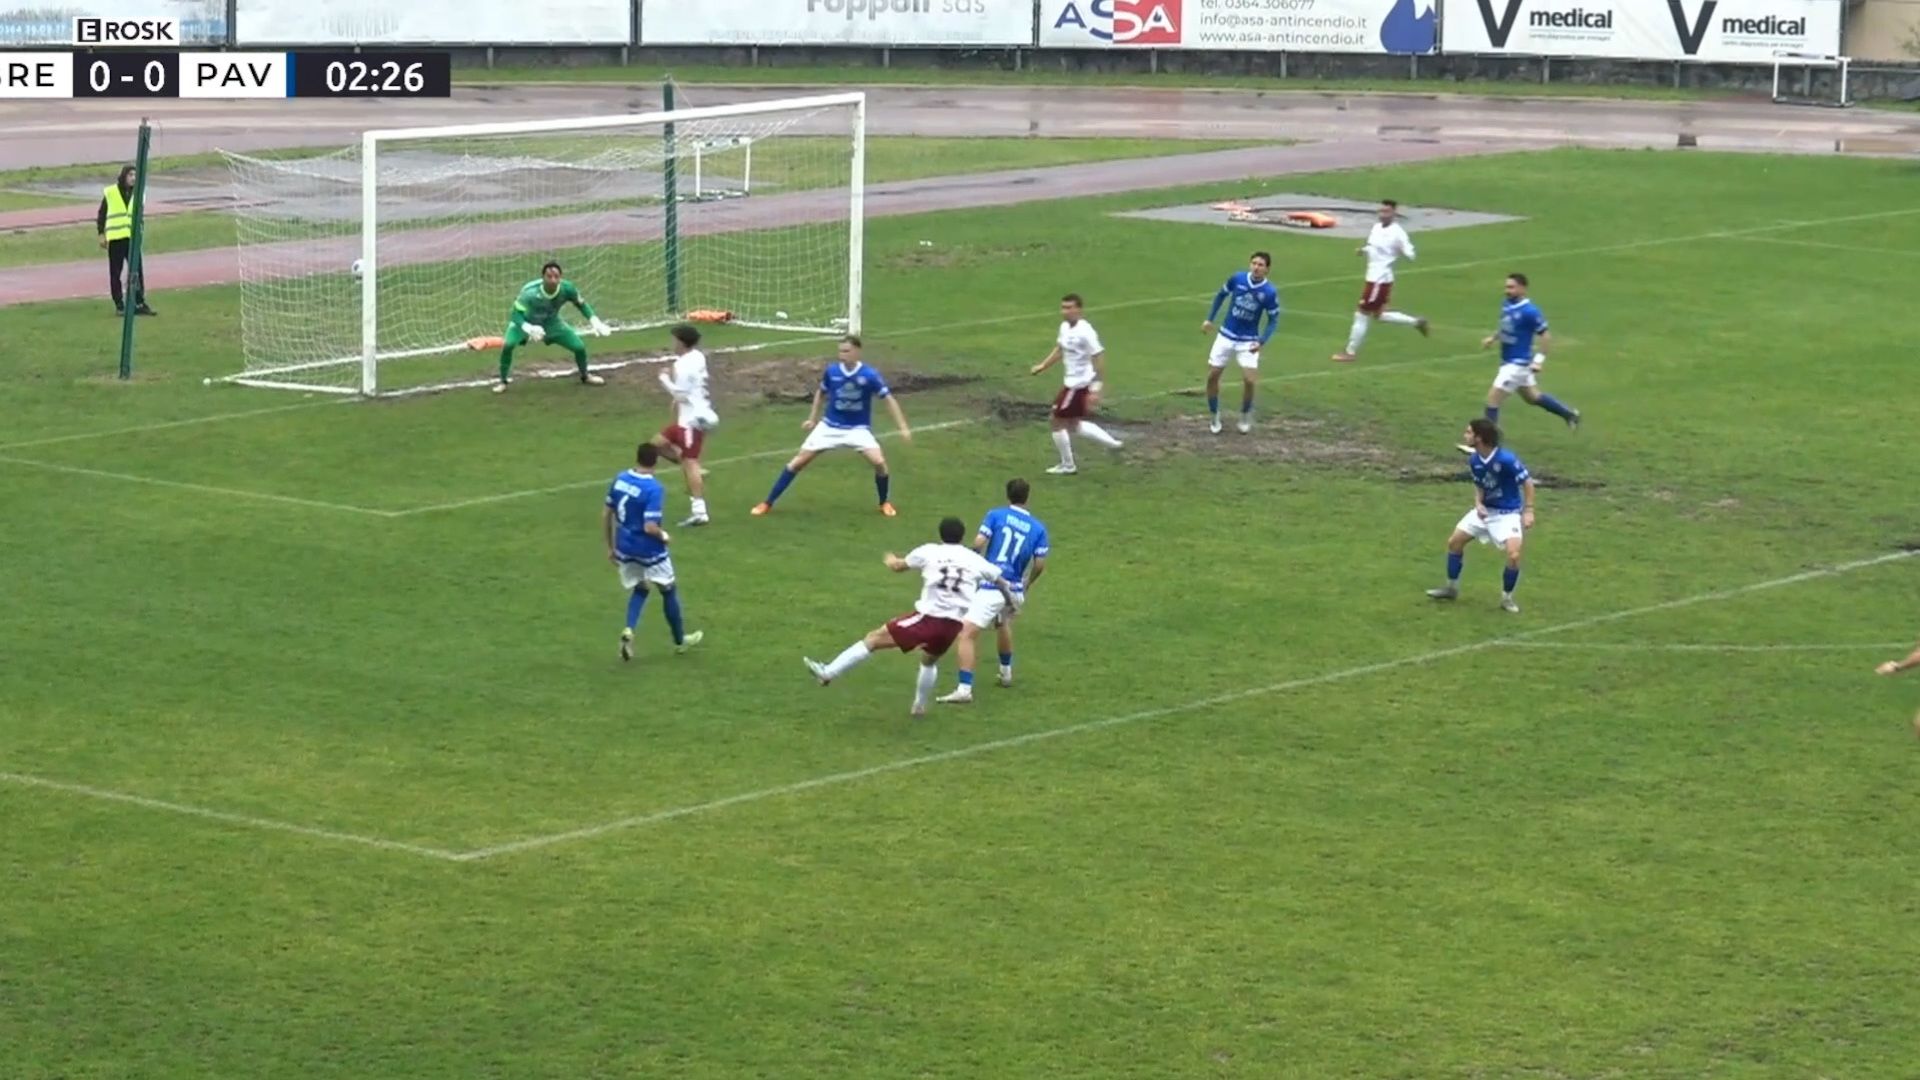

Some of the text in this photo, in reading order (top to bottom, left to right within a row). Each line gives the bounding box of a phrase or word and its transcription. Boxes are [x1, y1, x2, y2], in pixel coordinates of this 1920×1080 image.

[1200, 13, 1367, 29] info@asa-antincendio.it
[1530, 8, 1612, 29] medical
[1667, 0, 1718, 55] V
[1722, 15, 1806, 36] medical
[1200, 31, 1364, 45] www.asa-antincendio.it
[938, 566, 964, 593] 11
